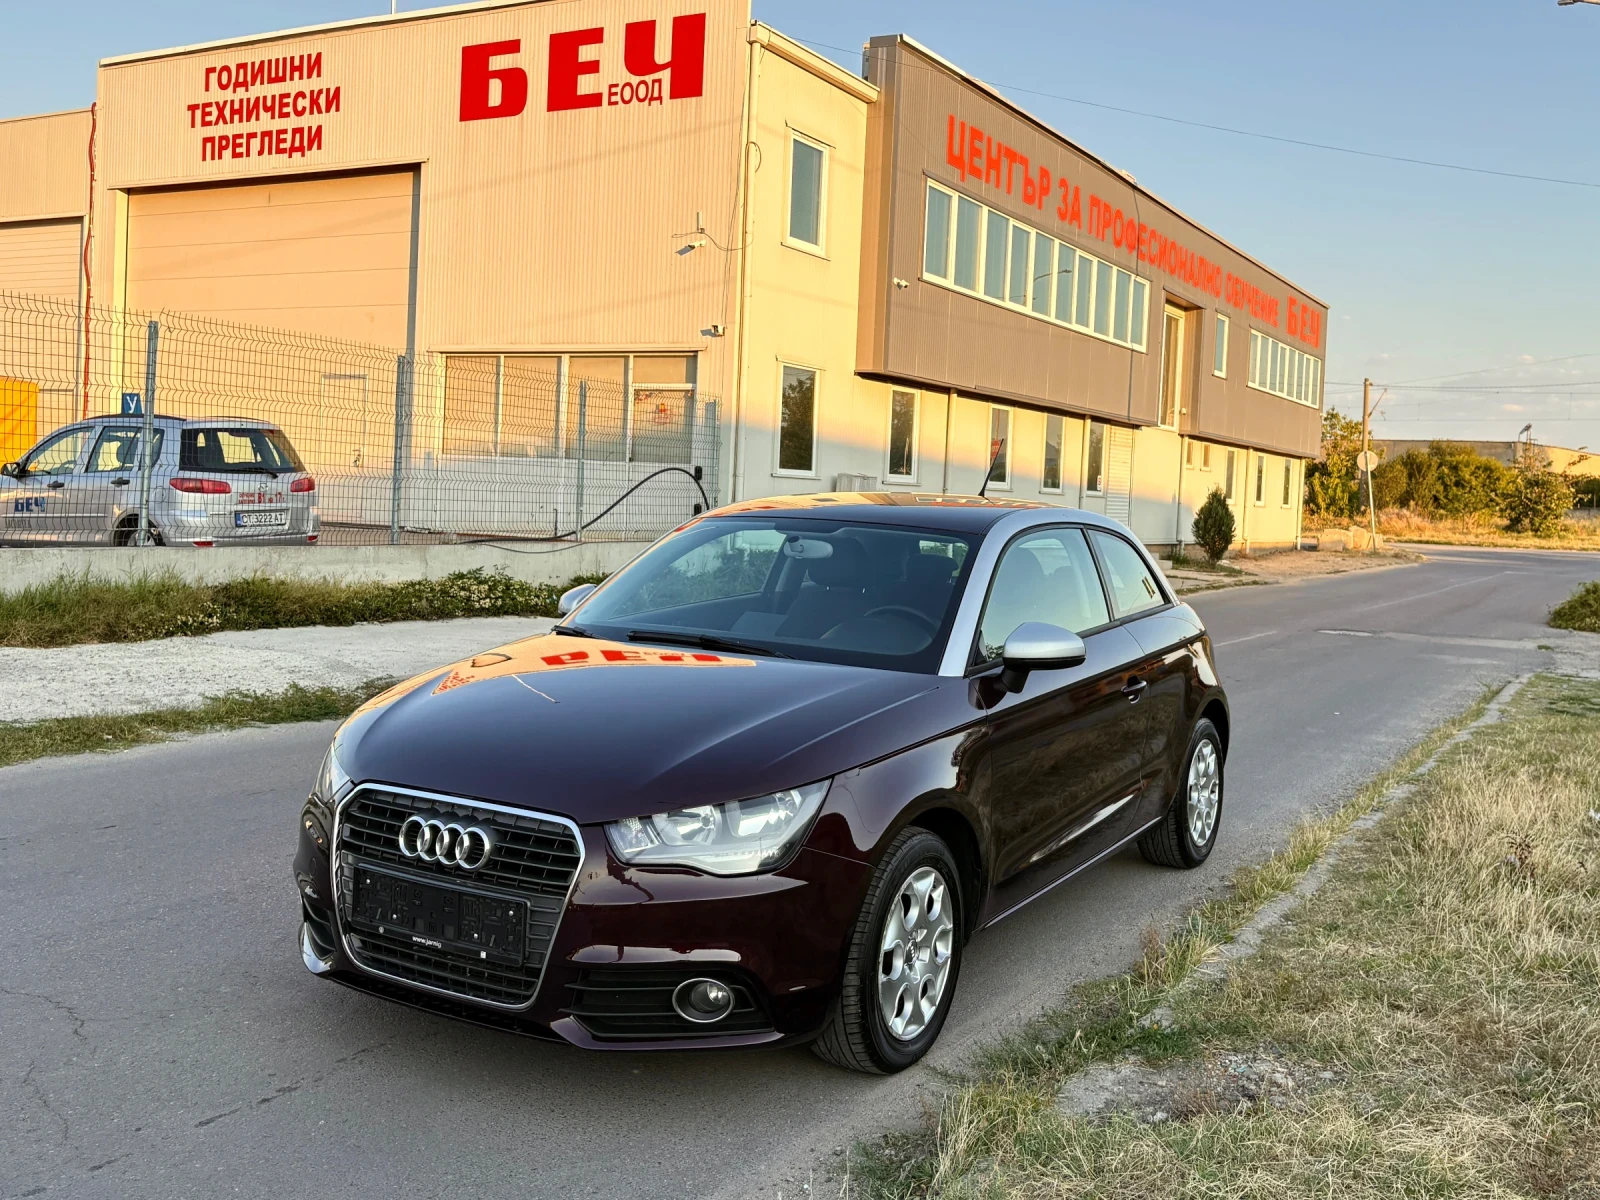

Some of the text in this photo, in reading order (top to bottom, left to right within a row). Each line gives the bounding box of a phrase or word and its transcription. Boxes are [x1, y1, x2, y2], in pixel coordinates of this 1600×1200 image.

[204, 52, 323, 94] ГОДИШНИ
[458, 13, 706, 123] БЕЧ
[187, 86, 341, 129] ТЕХНИЧЕСКИ
[607, 77, 664, 107] ЕООД
[201, 124, 323, 162] ПРЕГЛЕДИ
[945, 112, 1321, 349] ЦЕНТЪР ЗА ПРОФЕСИОНАЛНО ОБУЧЕНИЕ БЕЧ
[15, 496, 46, 513] БЕЧ
